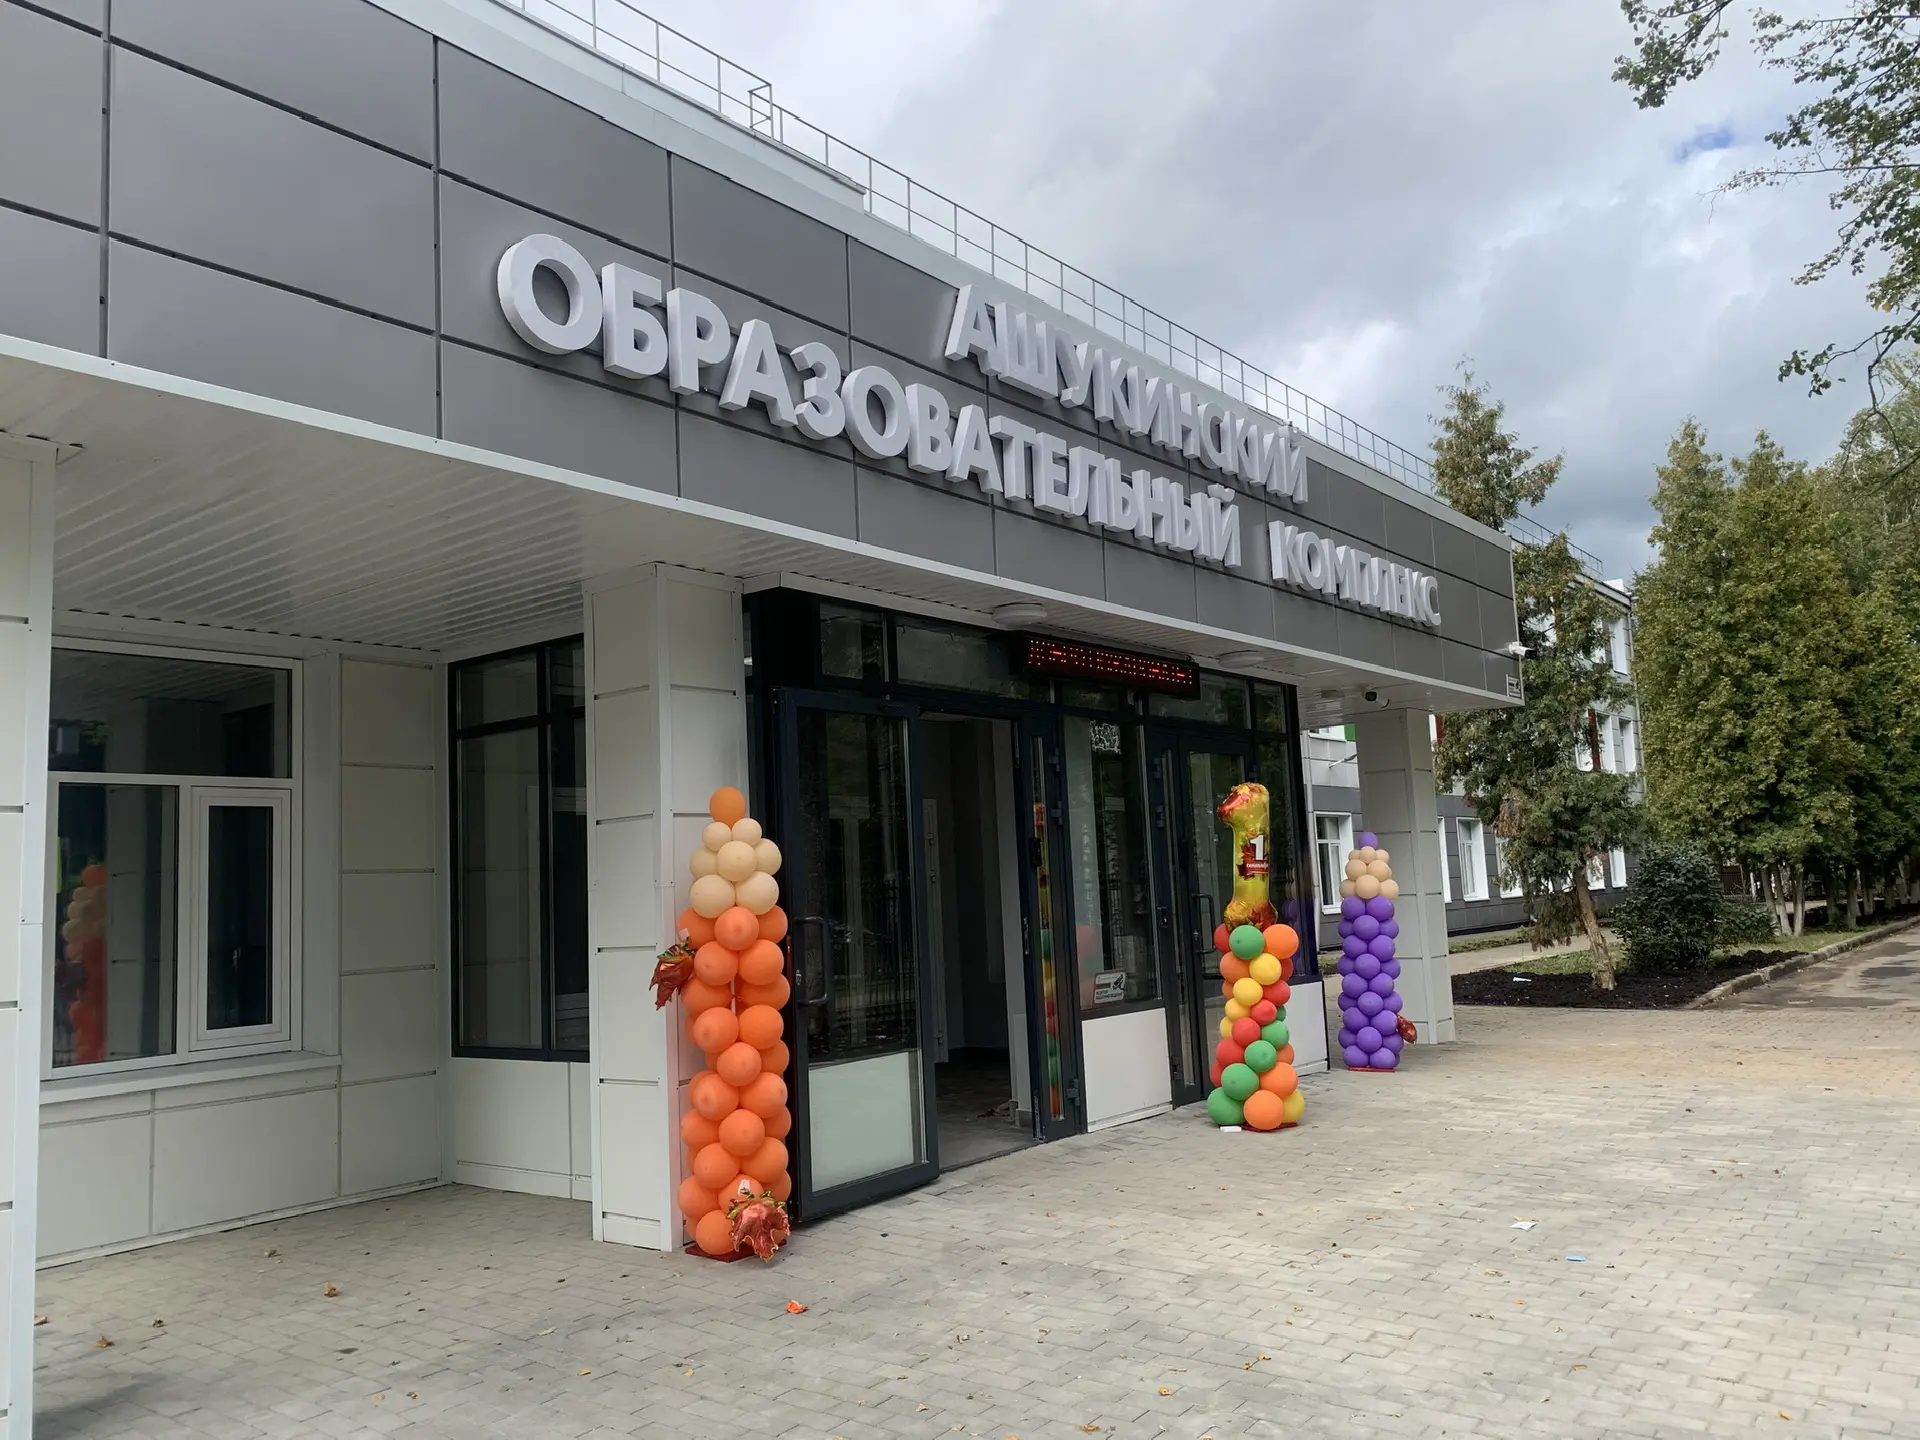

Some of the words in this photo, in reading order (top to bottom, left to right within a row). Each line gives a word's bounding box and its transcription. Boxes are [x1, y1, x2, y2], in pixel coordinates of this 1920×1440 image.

[497, 233, 1241, 567] ОБРАЗОВАТЕЛЬНЫЙ
[1268, 520, 1442, 626] КОМПЛЕКС
[945, 284, 1308, 503] АШУКИНСКИЙ
[1250, 834, 1264, 860] 1
